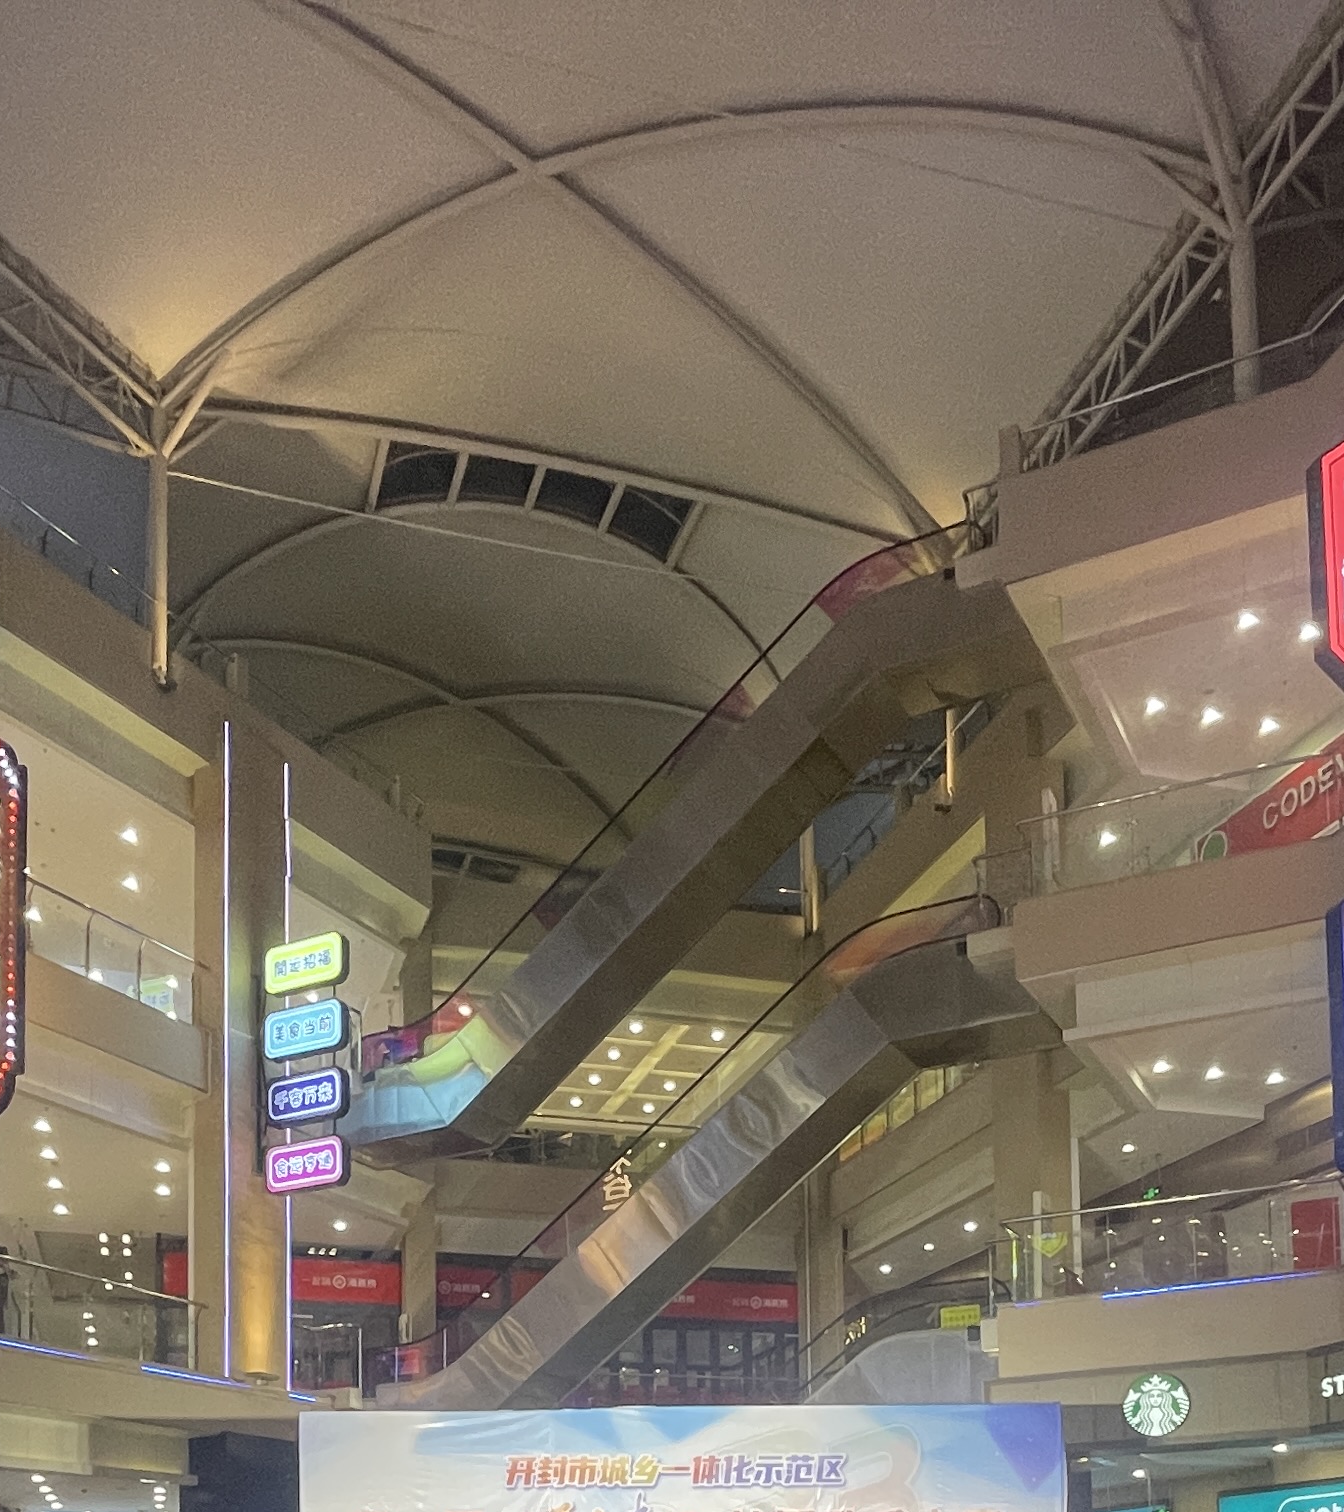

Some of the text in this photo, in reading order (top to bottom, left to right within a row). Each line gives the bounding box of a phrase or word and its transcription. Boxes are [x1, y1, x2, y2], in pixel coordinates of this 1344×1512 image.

[506, 1454, 847, 1487] 开封市城乡一体化示范区
